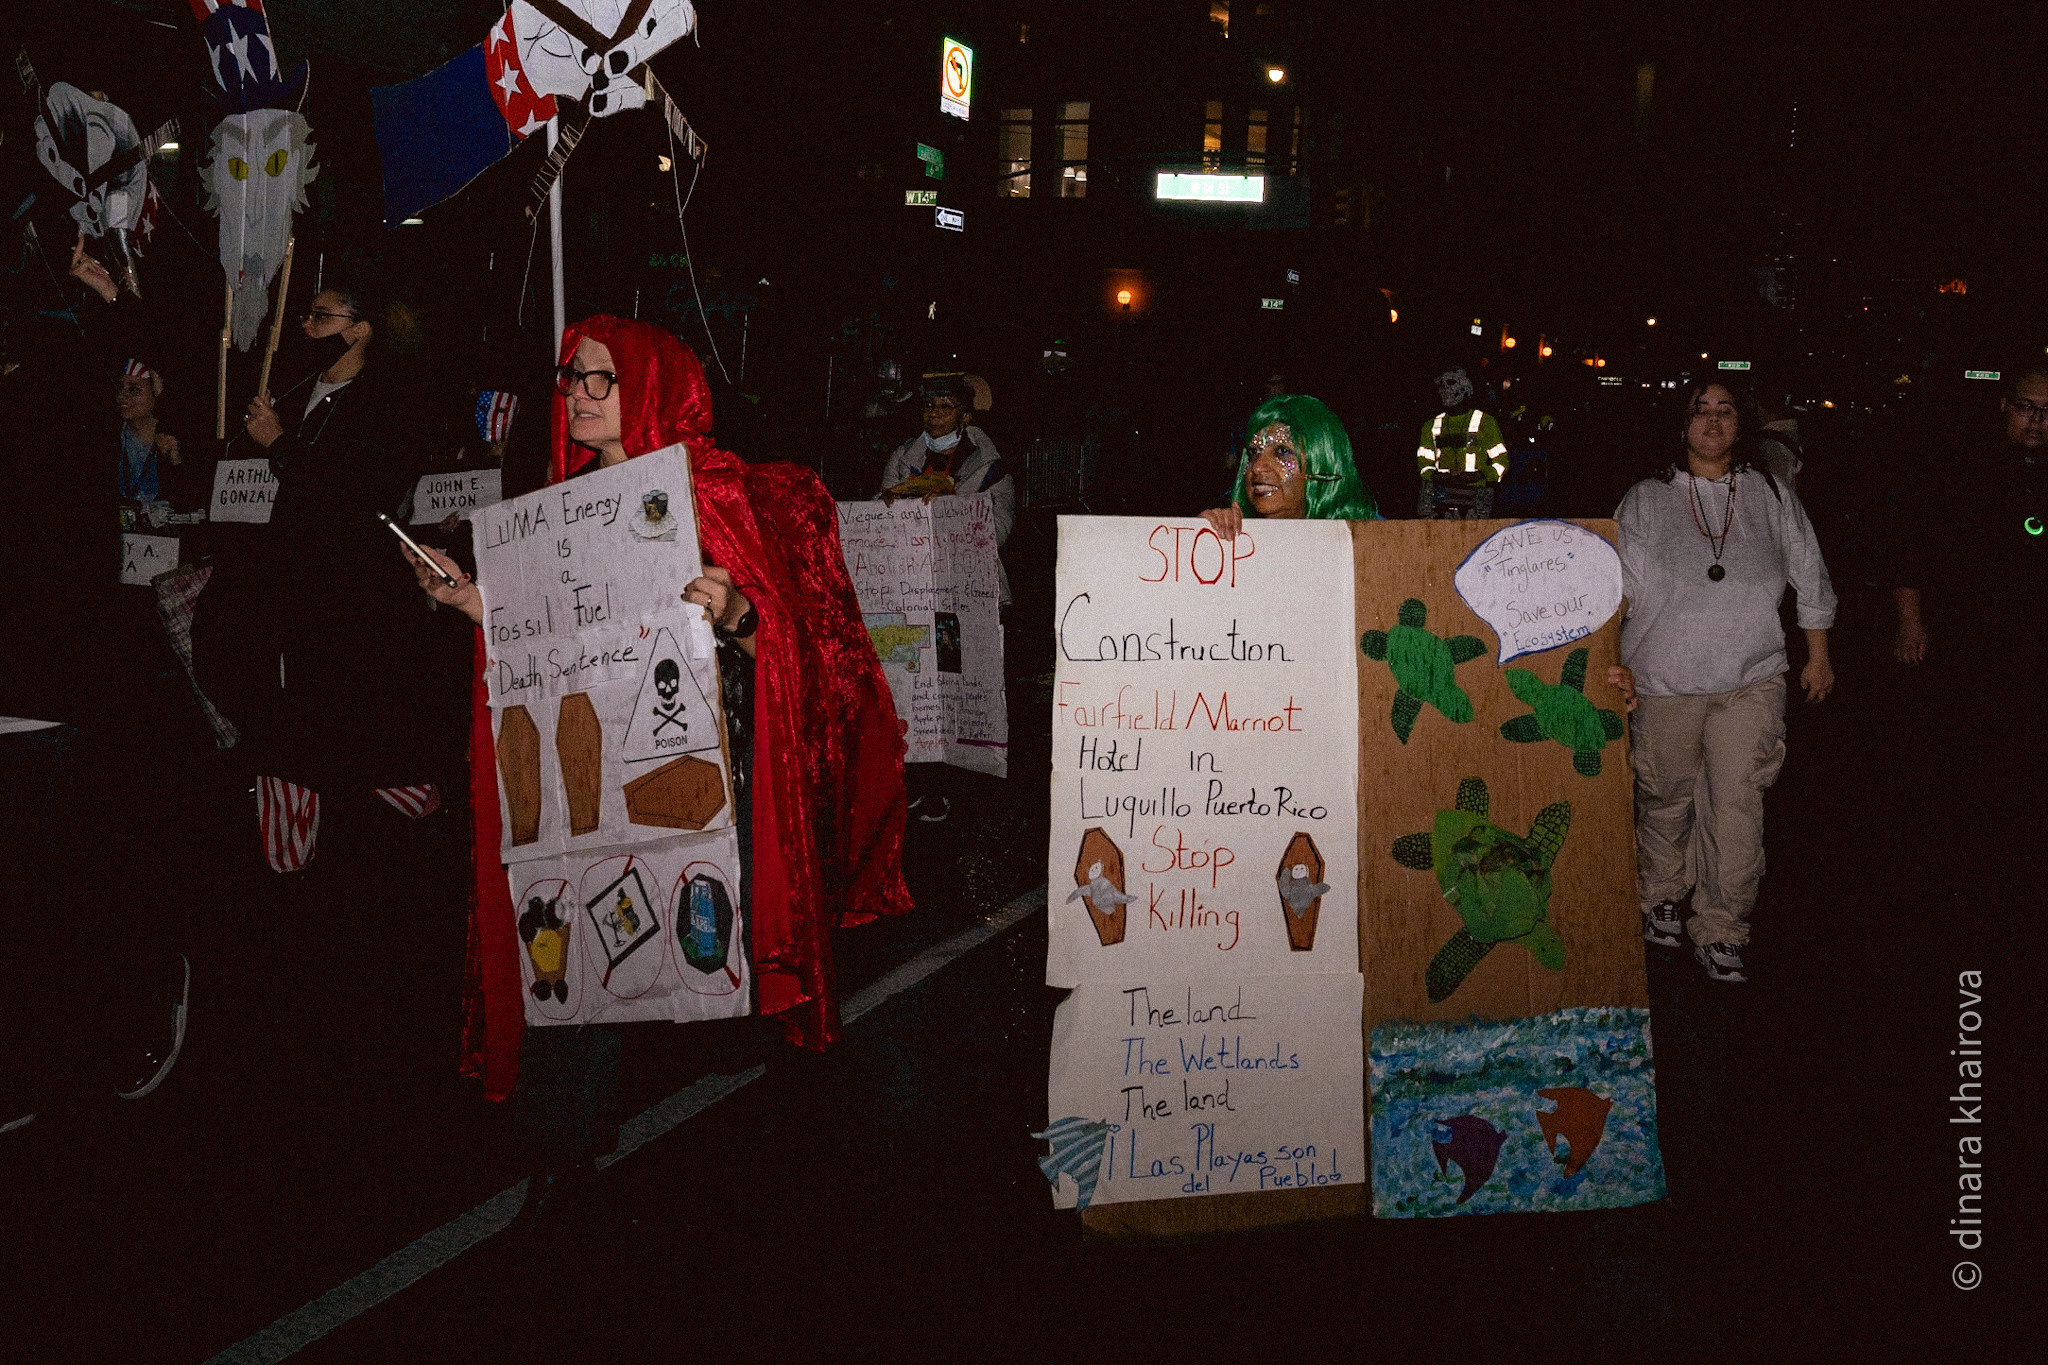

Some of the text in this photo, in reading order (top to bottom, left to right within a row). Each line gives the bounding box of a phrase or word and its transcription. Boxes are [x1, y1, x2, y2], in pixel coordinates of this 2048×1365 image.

[906, 192, 915, 204] W
[917, 192, 930, 204] 14
[225, 468, 275, 485] ARTHU
[426, 477, 484, 494] JOHN E.
[431, 493, 477, 510] NIXON
[561, 490, 622, 527] Energy
[143, 544, 159, 557] A.
[1138, 524, 1256, 588] STOP
[1481, 526, 1574, 566] SAVE US
[125, 560, 137, 573] A
[561, 570, 577, 585] a
[490, 584, 612, 646] Fossil Fuel
[1060, 592, 1295, 662] Construction
[1506, 600, 1553, 629] Save
[1058, 681, 1178, 731] Fairfield
[654, 735, 689, 750] POISON
[1079, 735, 1142, 772] Hotel
[1080, 776, 1328, 839] Luquillo Puerto Rico
[1142, 824, 1236, 889] Stop
[1149, 882, 1240, 952] Killing
[1122, 986, 1257, 1028] The land
[1121, 1034, 1301, 1076] The Wetlands
[1120, 1078, 1236, 1121] The land
[1190, 1122, 1269, 1183] Playas
[1273, 1144, 1317, 1161] son
[1181, 1172, 1211, 1193] del
